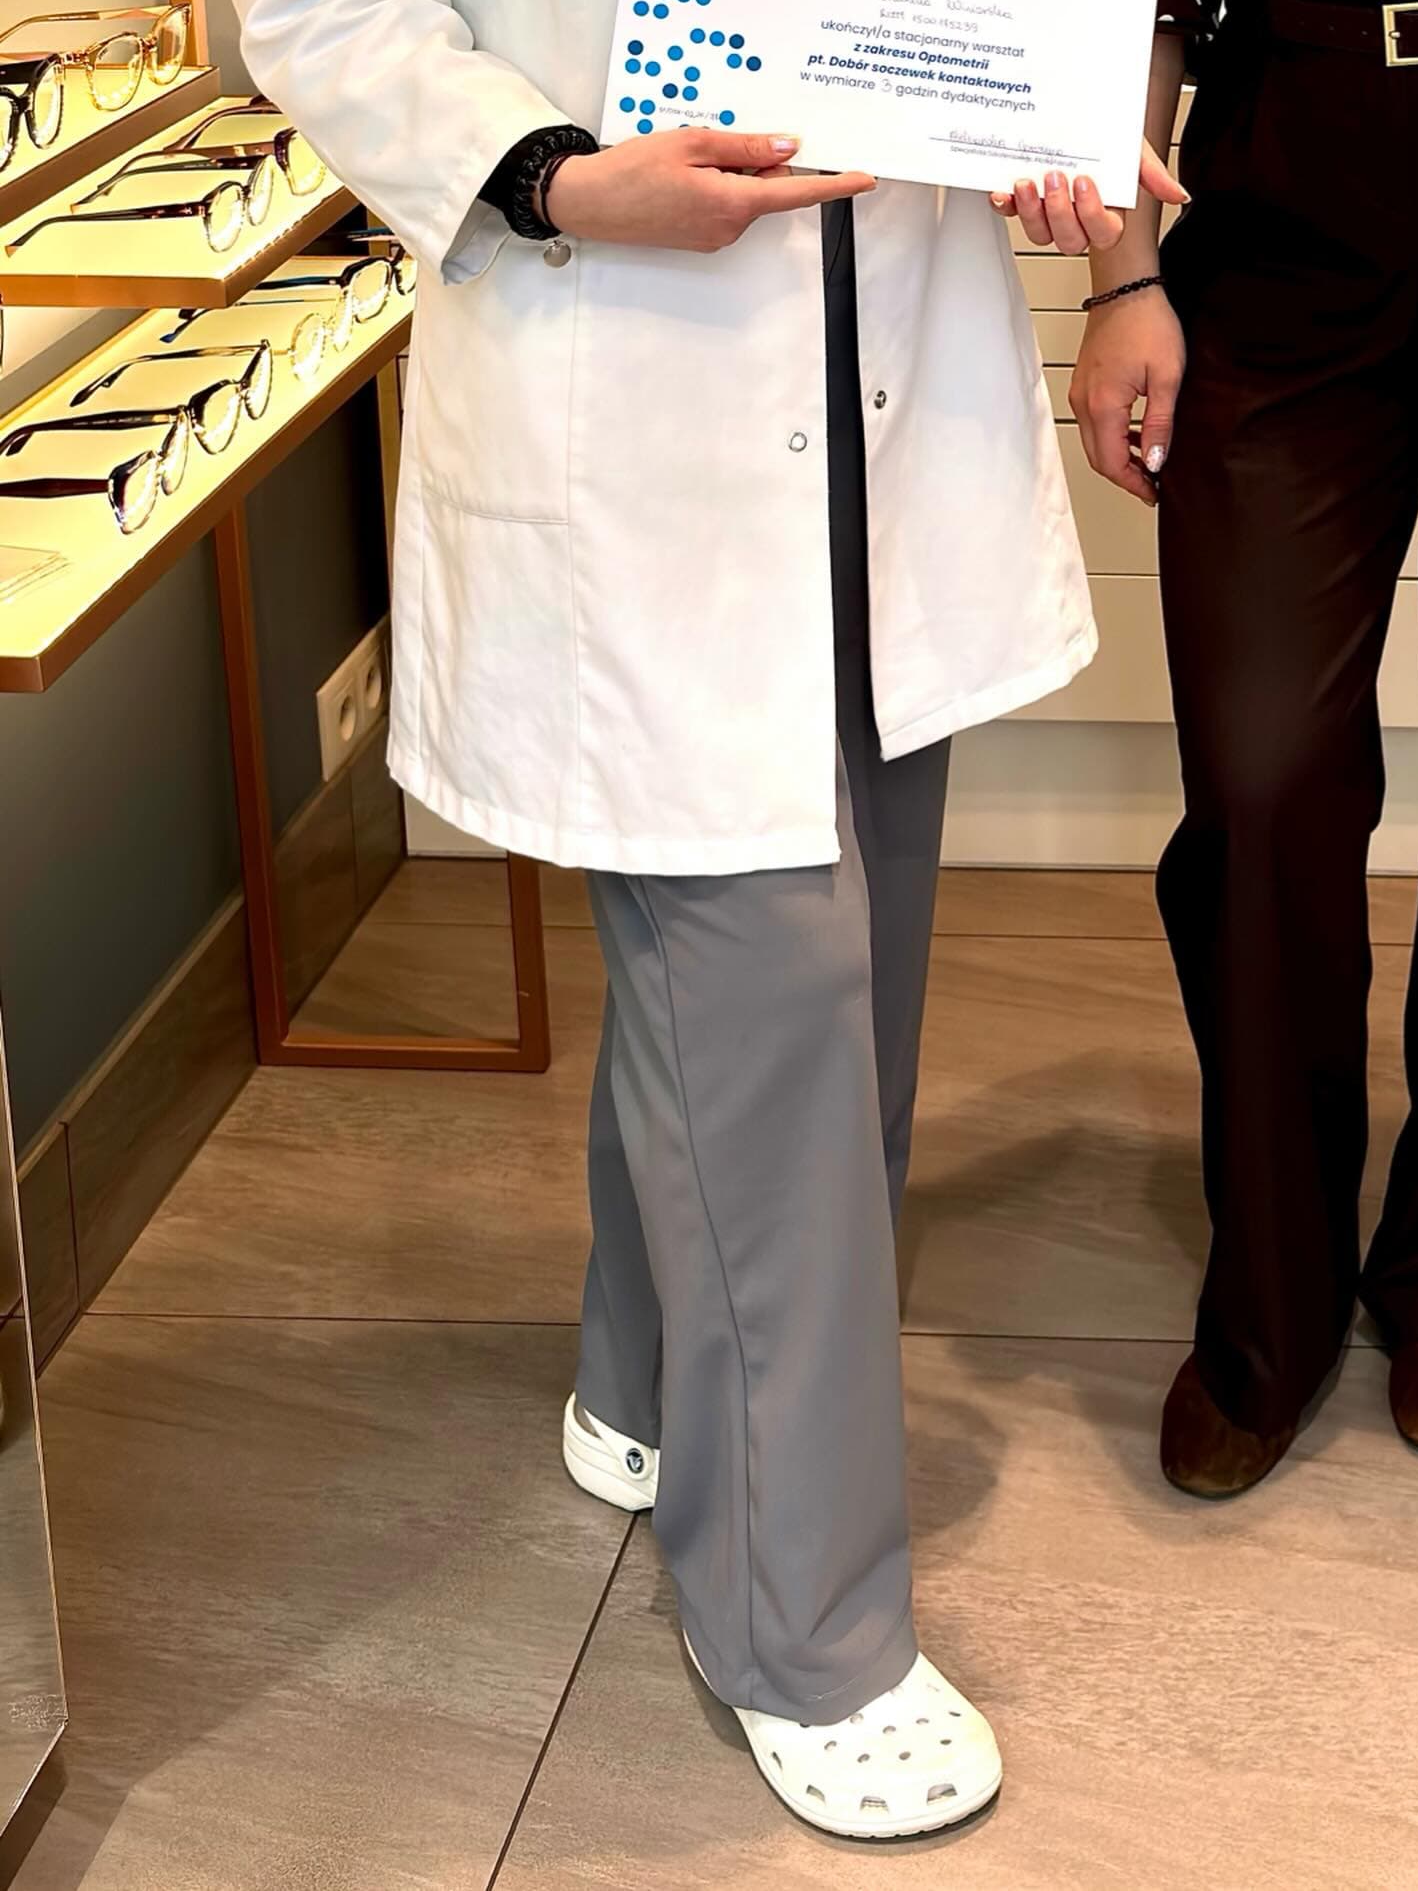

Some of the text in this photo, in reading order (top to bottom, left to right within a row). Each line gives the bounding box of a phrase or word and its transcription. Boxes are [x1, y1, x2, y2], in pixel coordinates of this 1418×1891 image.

[821, 19, 1025, 59] ukończył/a stacjonarny warsztat
[853, 43, 989, 71] z zakresu Optometrii
[800, 71, 811, 81] w
[814, 73, 875, 90] wymiarze
[895, 83, 938, 99] godzin
[940, 87, 1036, 112] dydaktycznych
[808, 54, 1031, 94] pt. Dobór soczewek kontaktowych
